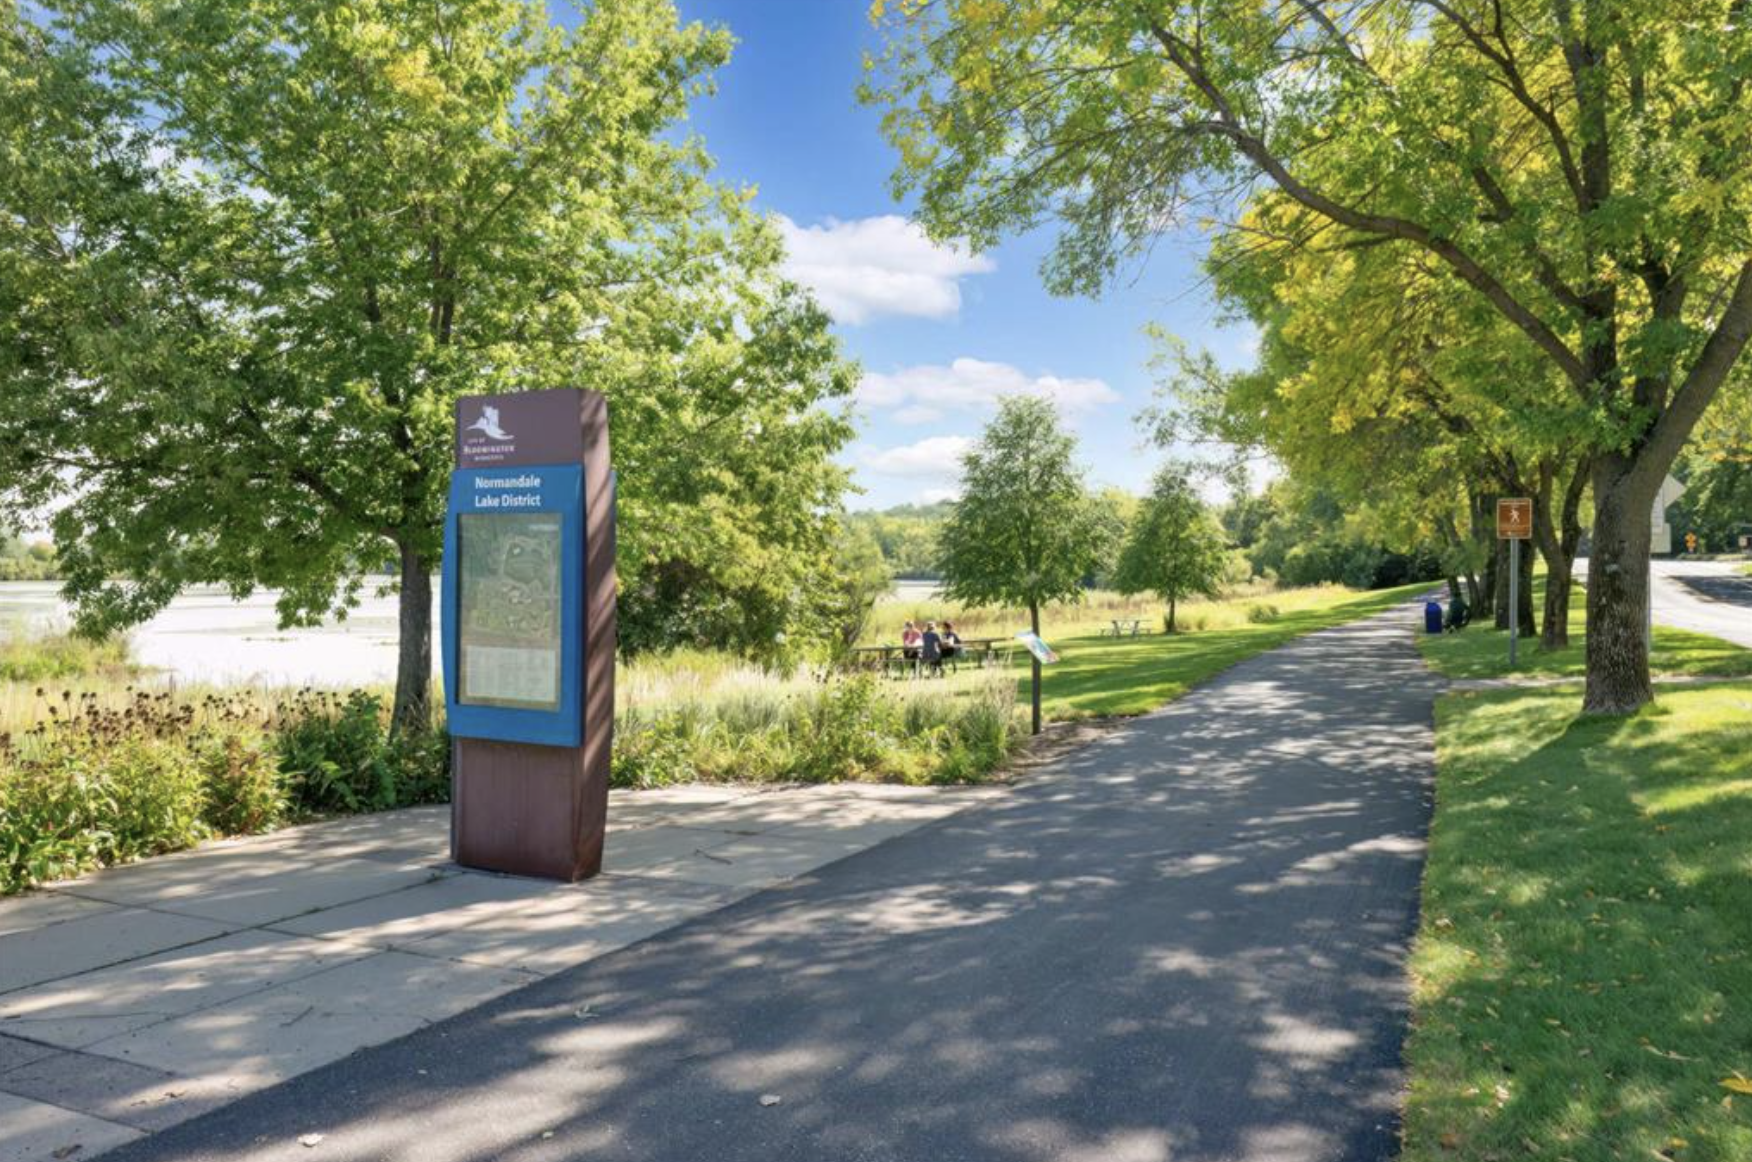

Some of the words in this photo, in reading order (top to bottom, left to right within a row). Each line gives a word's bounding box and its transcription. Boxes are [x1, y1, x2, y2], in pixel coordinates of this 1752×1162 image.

[475, 474, 541, 489] Normandale
[475, 495, 499, 507] Lake
[501, 493, 541, 507] District
